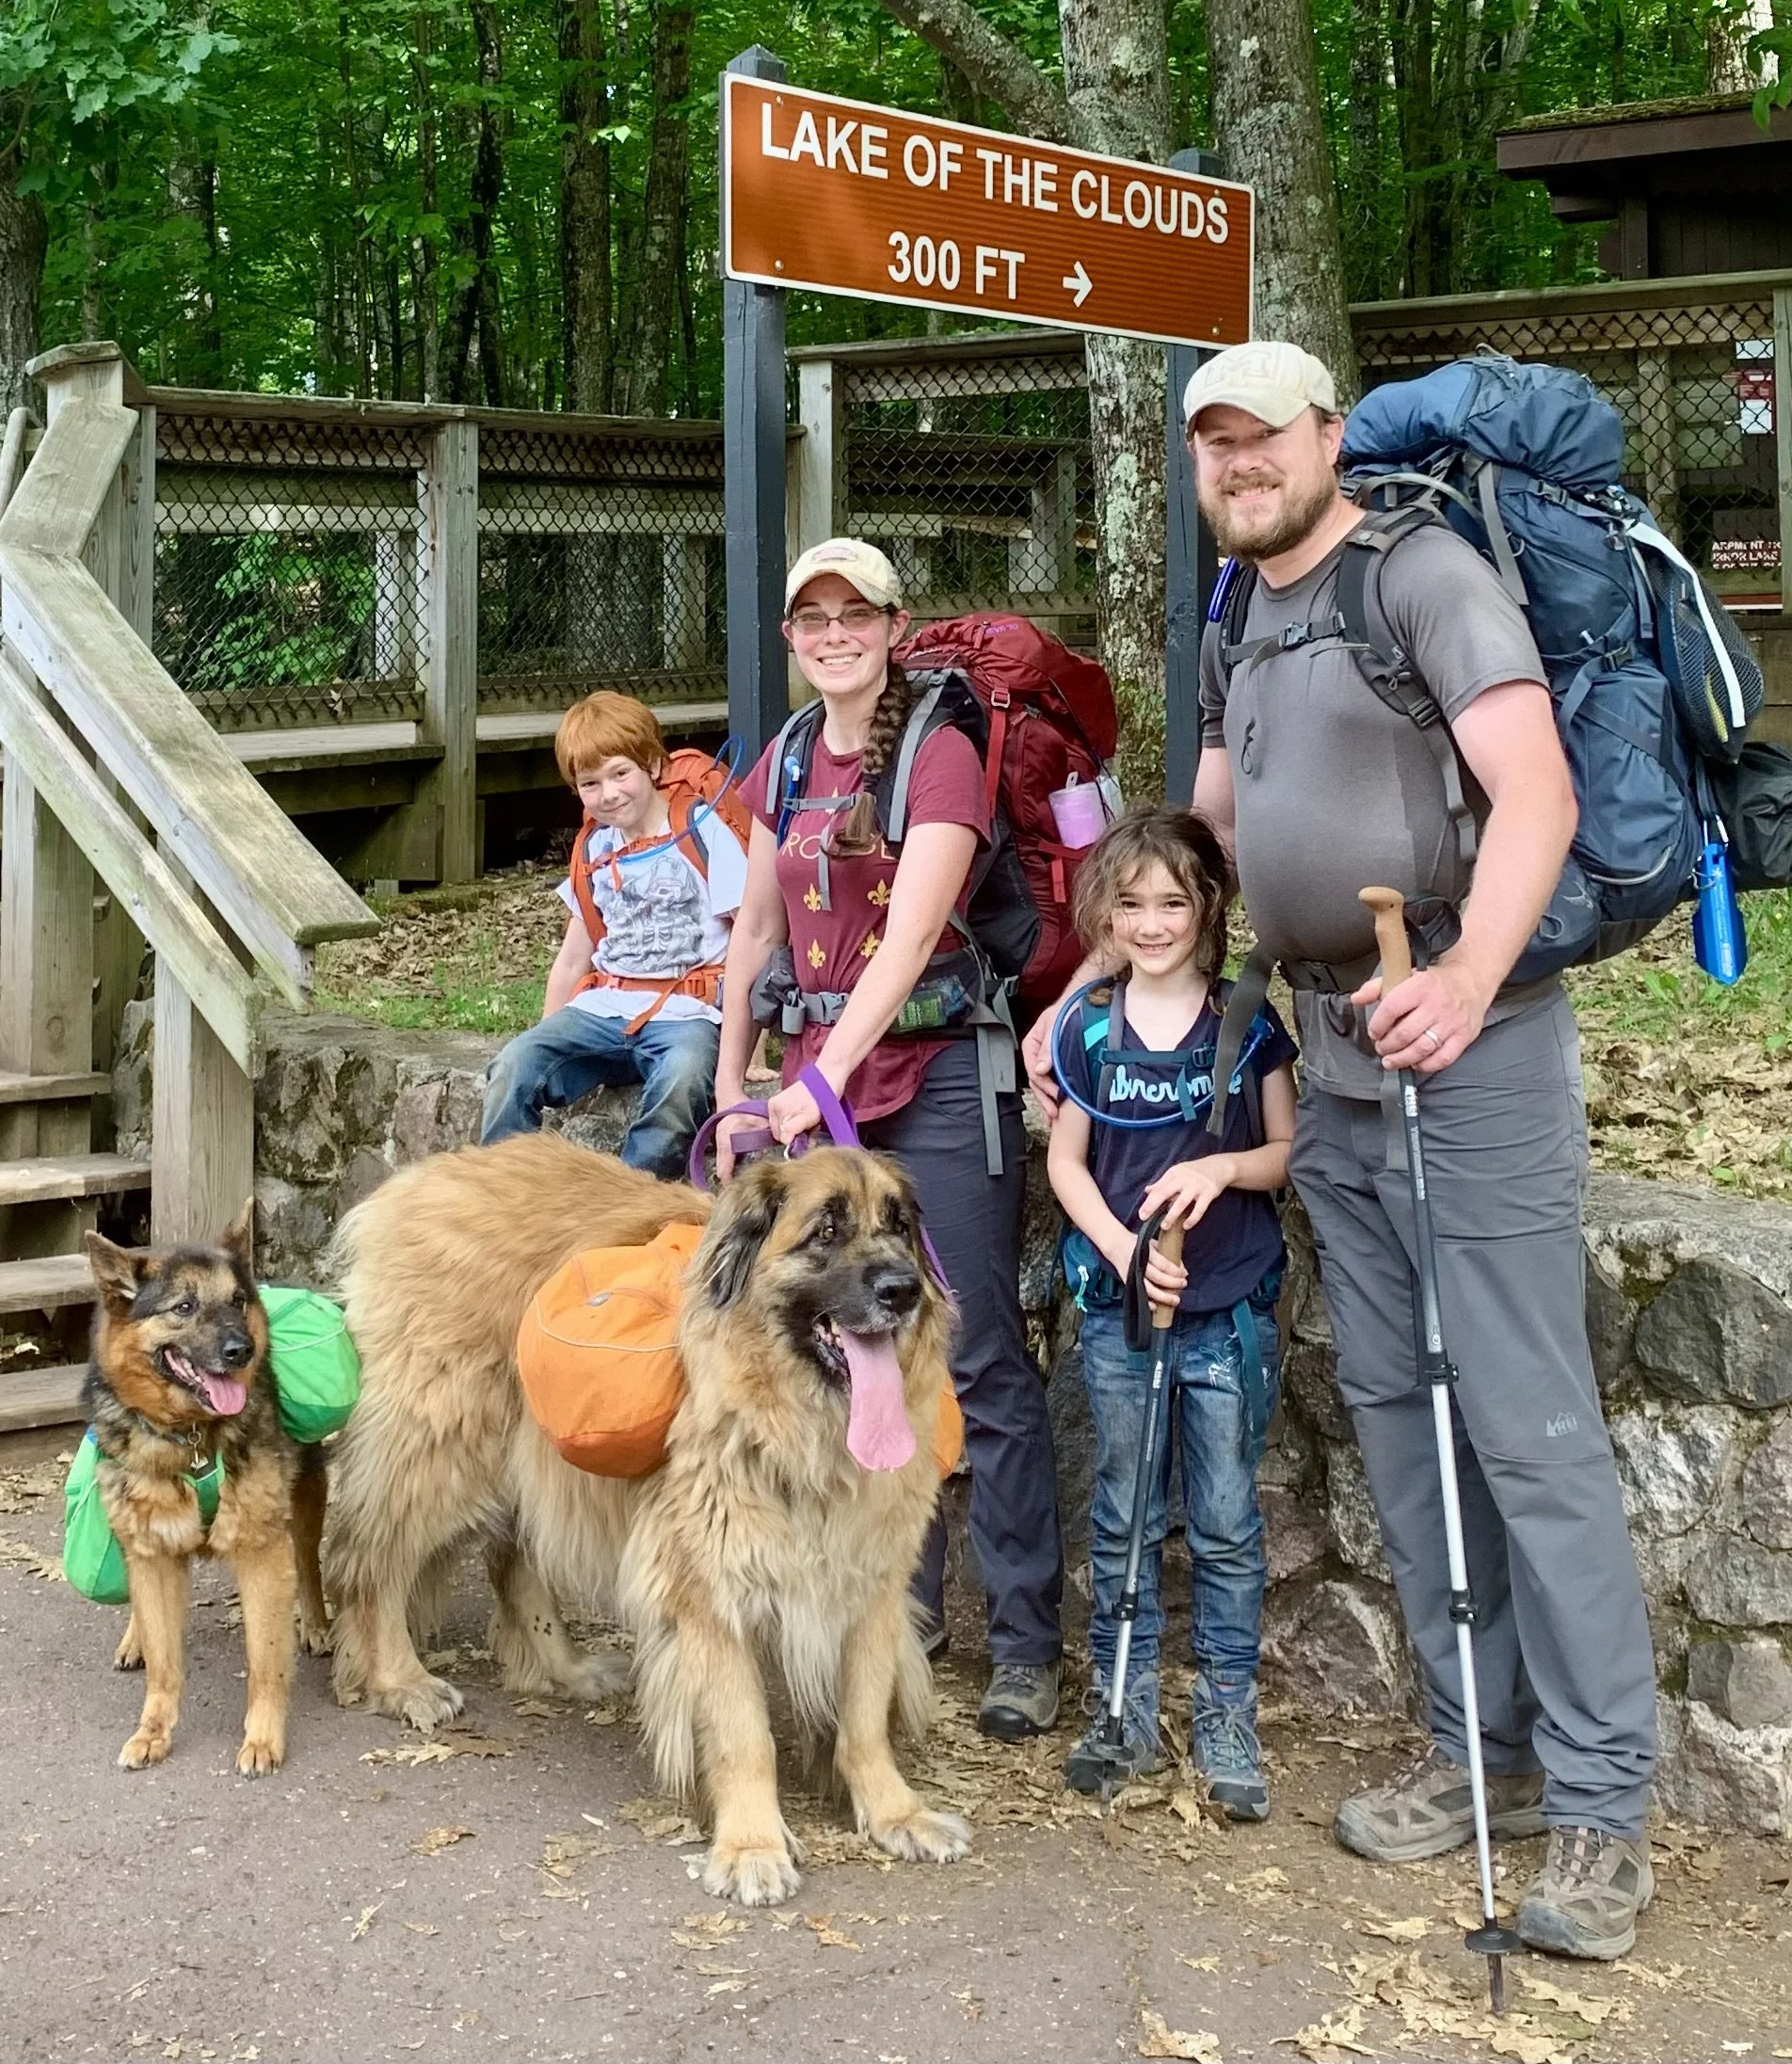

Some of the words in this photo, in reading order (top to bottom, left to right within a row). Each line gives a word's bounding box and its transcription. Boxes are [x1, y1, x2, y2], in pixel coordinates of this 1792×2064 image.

[761, 101, 889, 181] LAKE
[903, 135, 964, 191] OF
[976, 149, 1060, 213] THE
[1071, 169, 1229, 245] CLOUDS
[887, 231, 961, 291] 300
[975, 246, 1026, 300] FT
